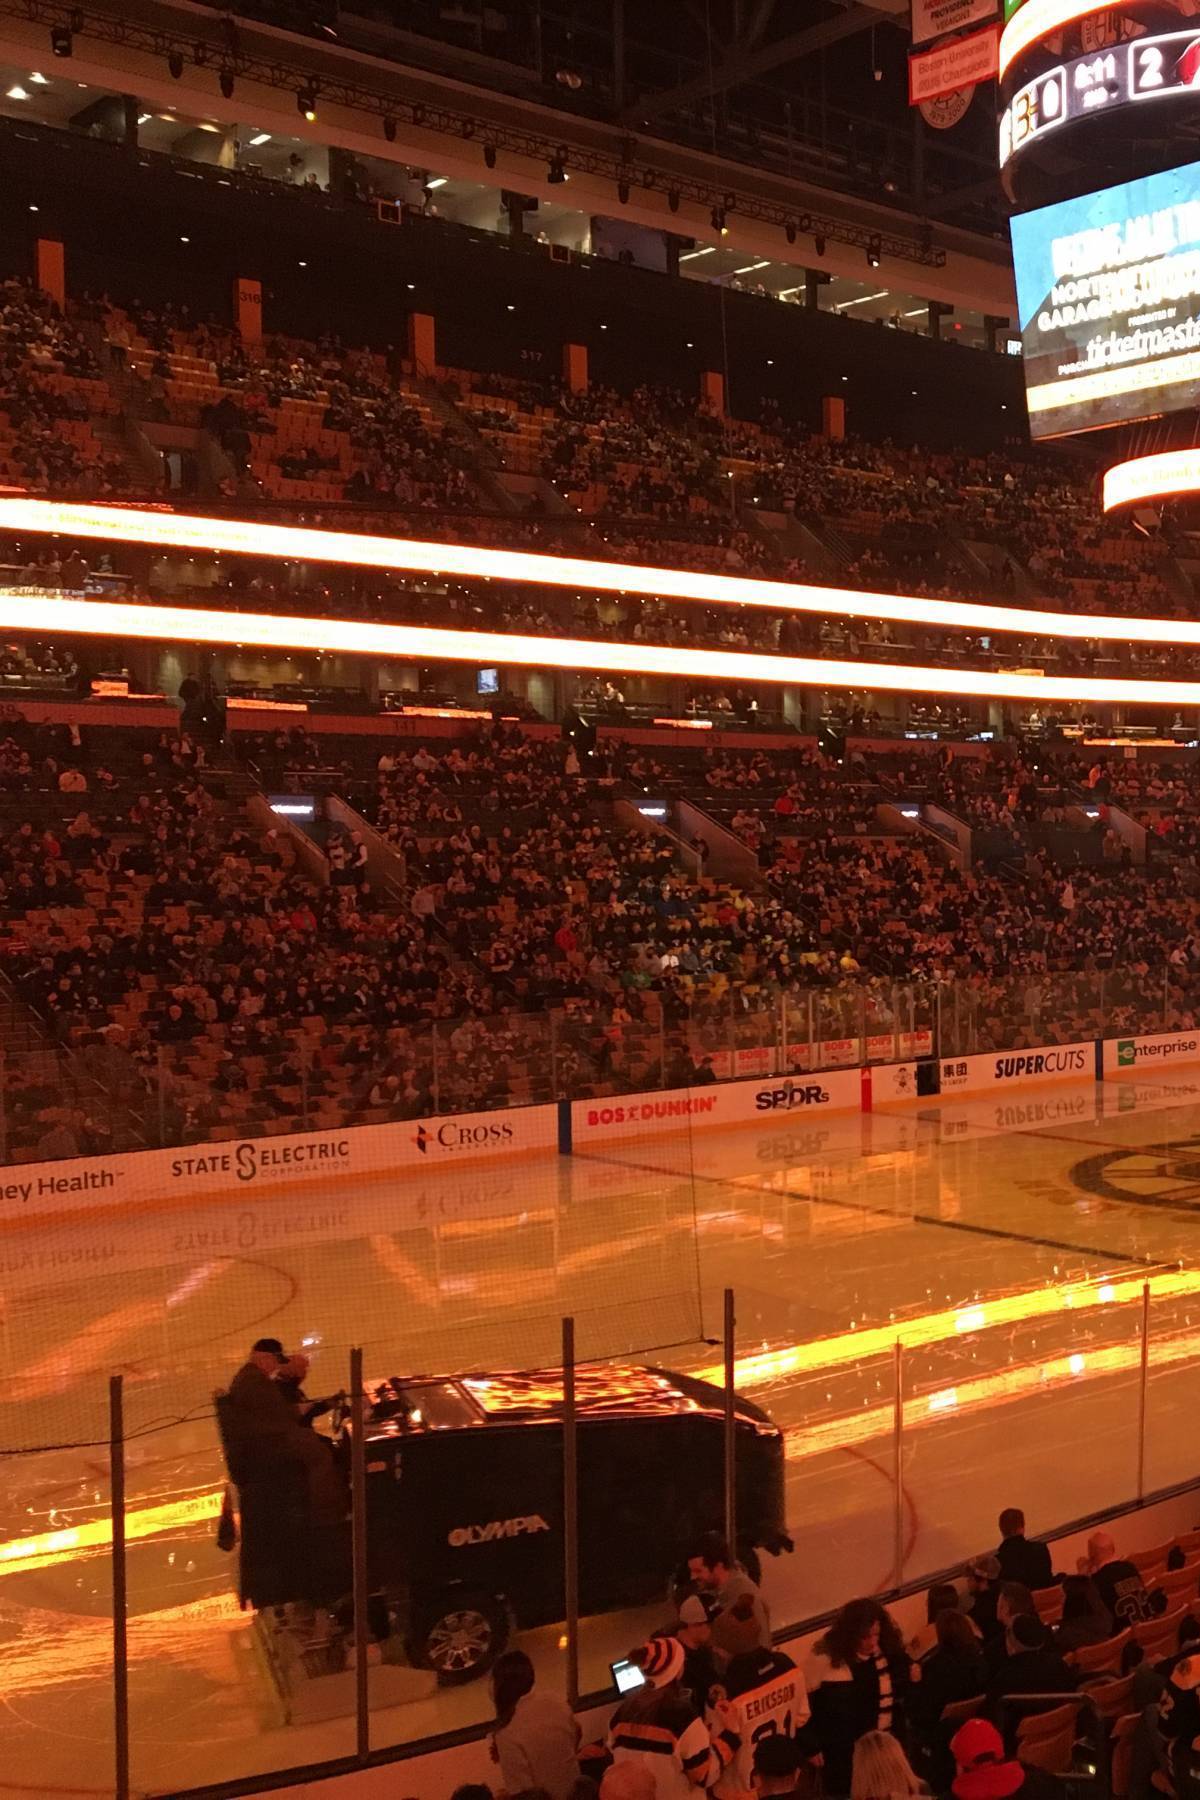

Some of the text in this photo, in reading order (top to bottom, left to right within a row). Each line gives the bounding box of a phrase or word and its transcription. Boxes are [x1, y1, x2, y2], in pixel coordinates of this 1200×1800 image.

[1139, 47, 1164, 87] 2
[1042, 79, 1060, 118] 0
[995, 1049, 1085, 1079] SUPERCUTS
[1121, 1039, 1197, 1062] enterprise
[587, 1096, 718, 1127] BOS DUNKIN'
[171, 1154, 231, 1177] STATE
[37, 1169, 114, 1196] Health
[448, 1513, 551, 1547] OLYMPIA
[745, 1682, 796, 1720] ERIKSSON
